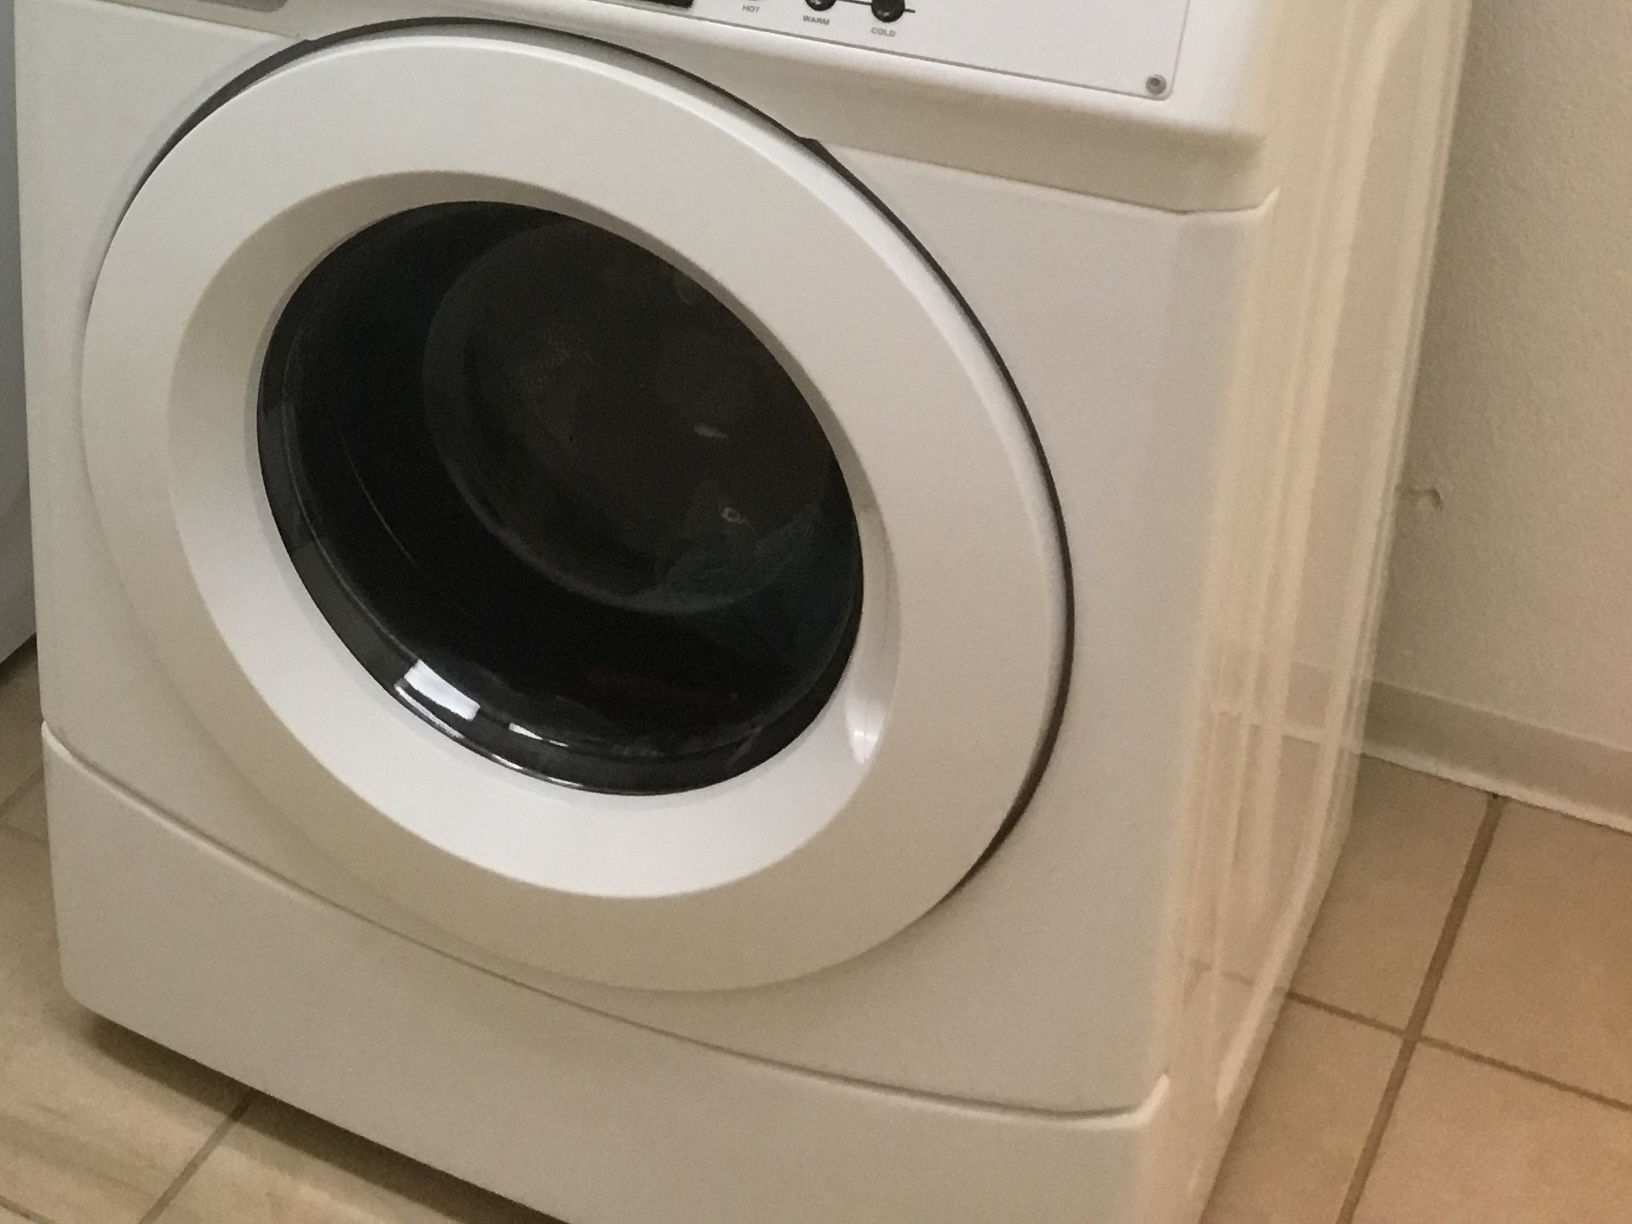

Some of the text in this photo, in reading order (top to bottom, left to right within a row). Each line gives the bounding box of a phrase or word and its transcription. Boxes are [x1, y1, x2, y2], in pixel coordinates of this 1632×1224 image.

[743, 5, 760, 13] HOT
[803, 15, 829, 26] WARM
[871, 27, 895, 37] COLD
